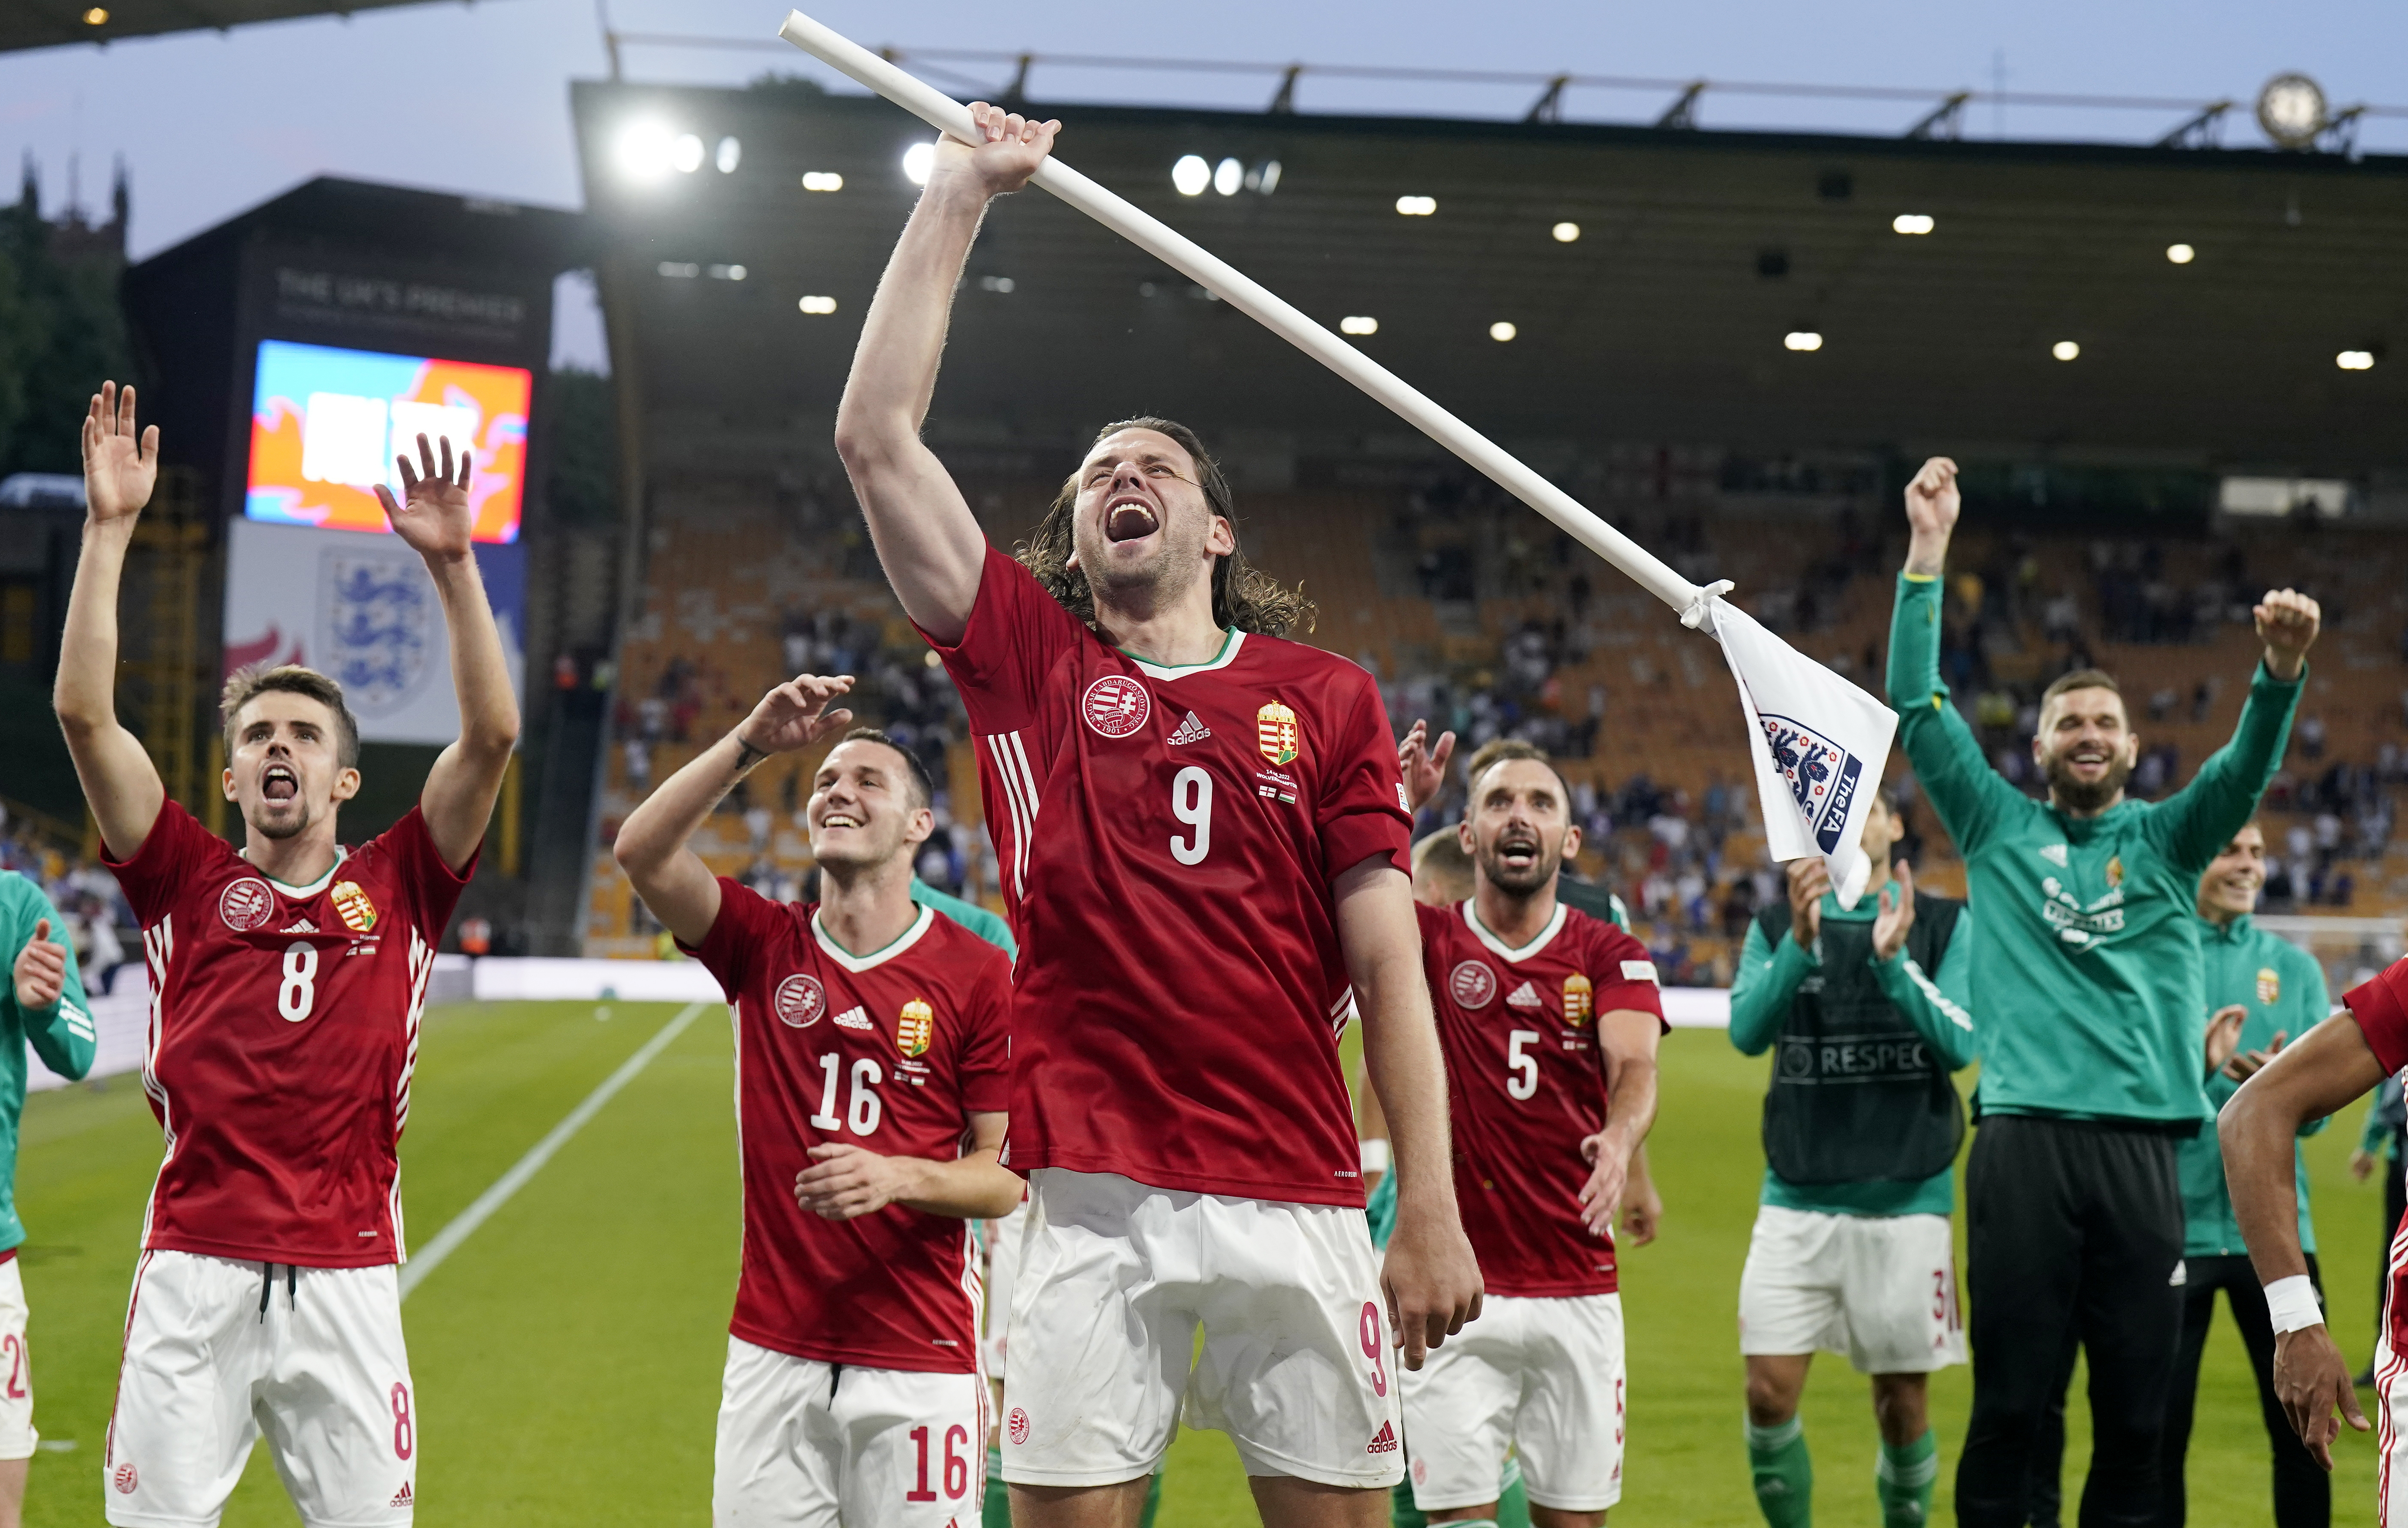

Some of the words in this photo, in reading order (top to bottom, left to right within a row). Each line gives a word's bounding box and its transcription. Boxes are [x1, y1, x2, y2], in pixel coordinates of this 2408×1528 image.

[1087, 692, 1097, 723] MAGYAR
[1094, 679, 1137, 692] LABDARÚGÓ
[1129, 690, 1146, 729] SZÖVETSÉG
[1167, 728, 1211, 745] adidas
[1170, 766, 1213, 865] 9
[278, 941, 318, 1023] 8
[833, 1016, 874, 1031] adidas
[1820, 1043, 1930, 1075] RESPEC
[810, 1052, 882, 1136] 16
[1507, 1029, 1540, 1100] 5
[1360, 1302, 1387, 1397] 9
[391, 1382, 412, 1460] 8
[1367, 1440, 1397, 1454] adidas
[907, 1424, 968, 1502] 16
